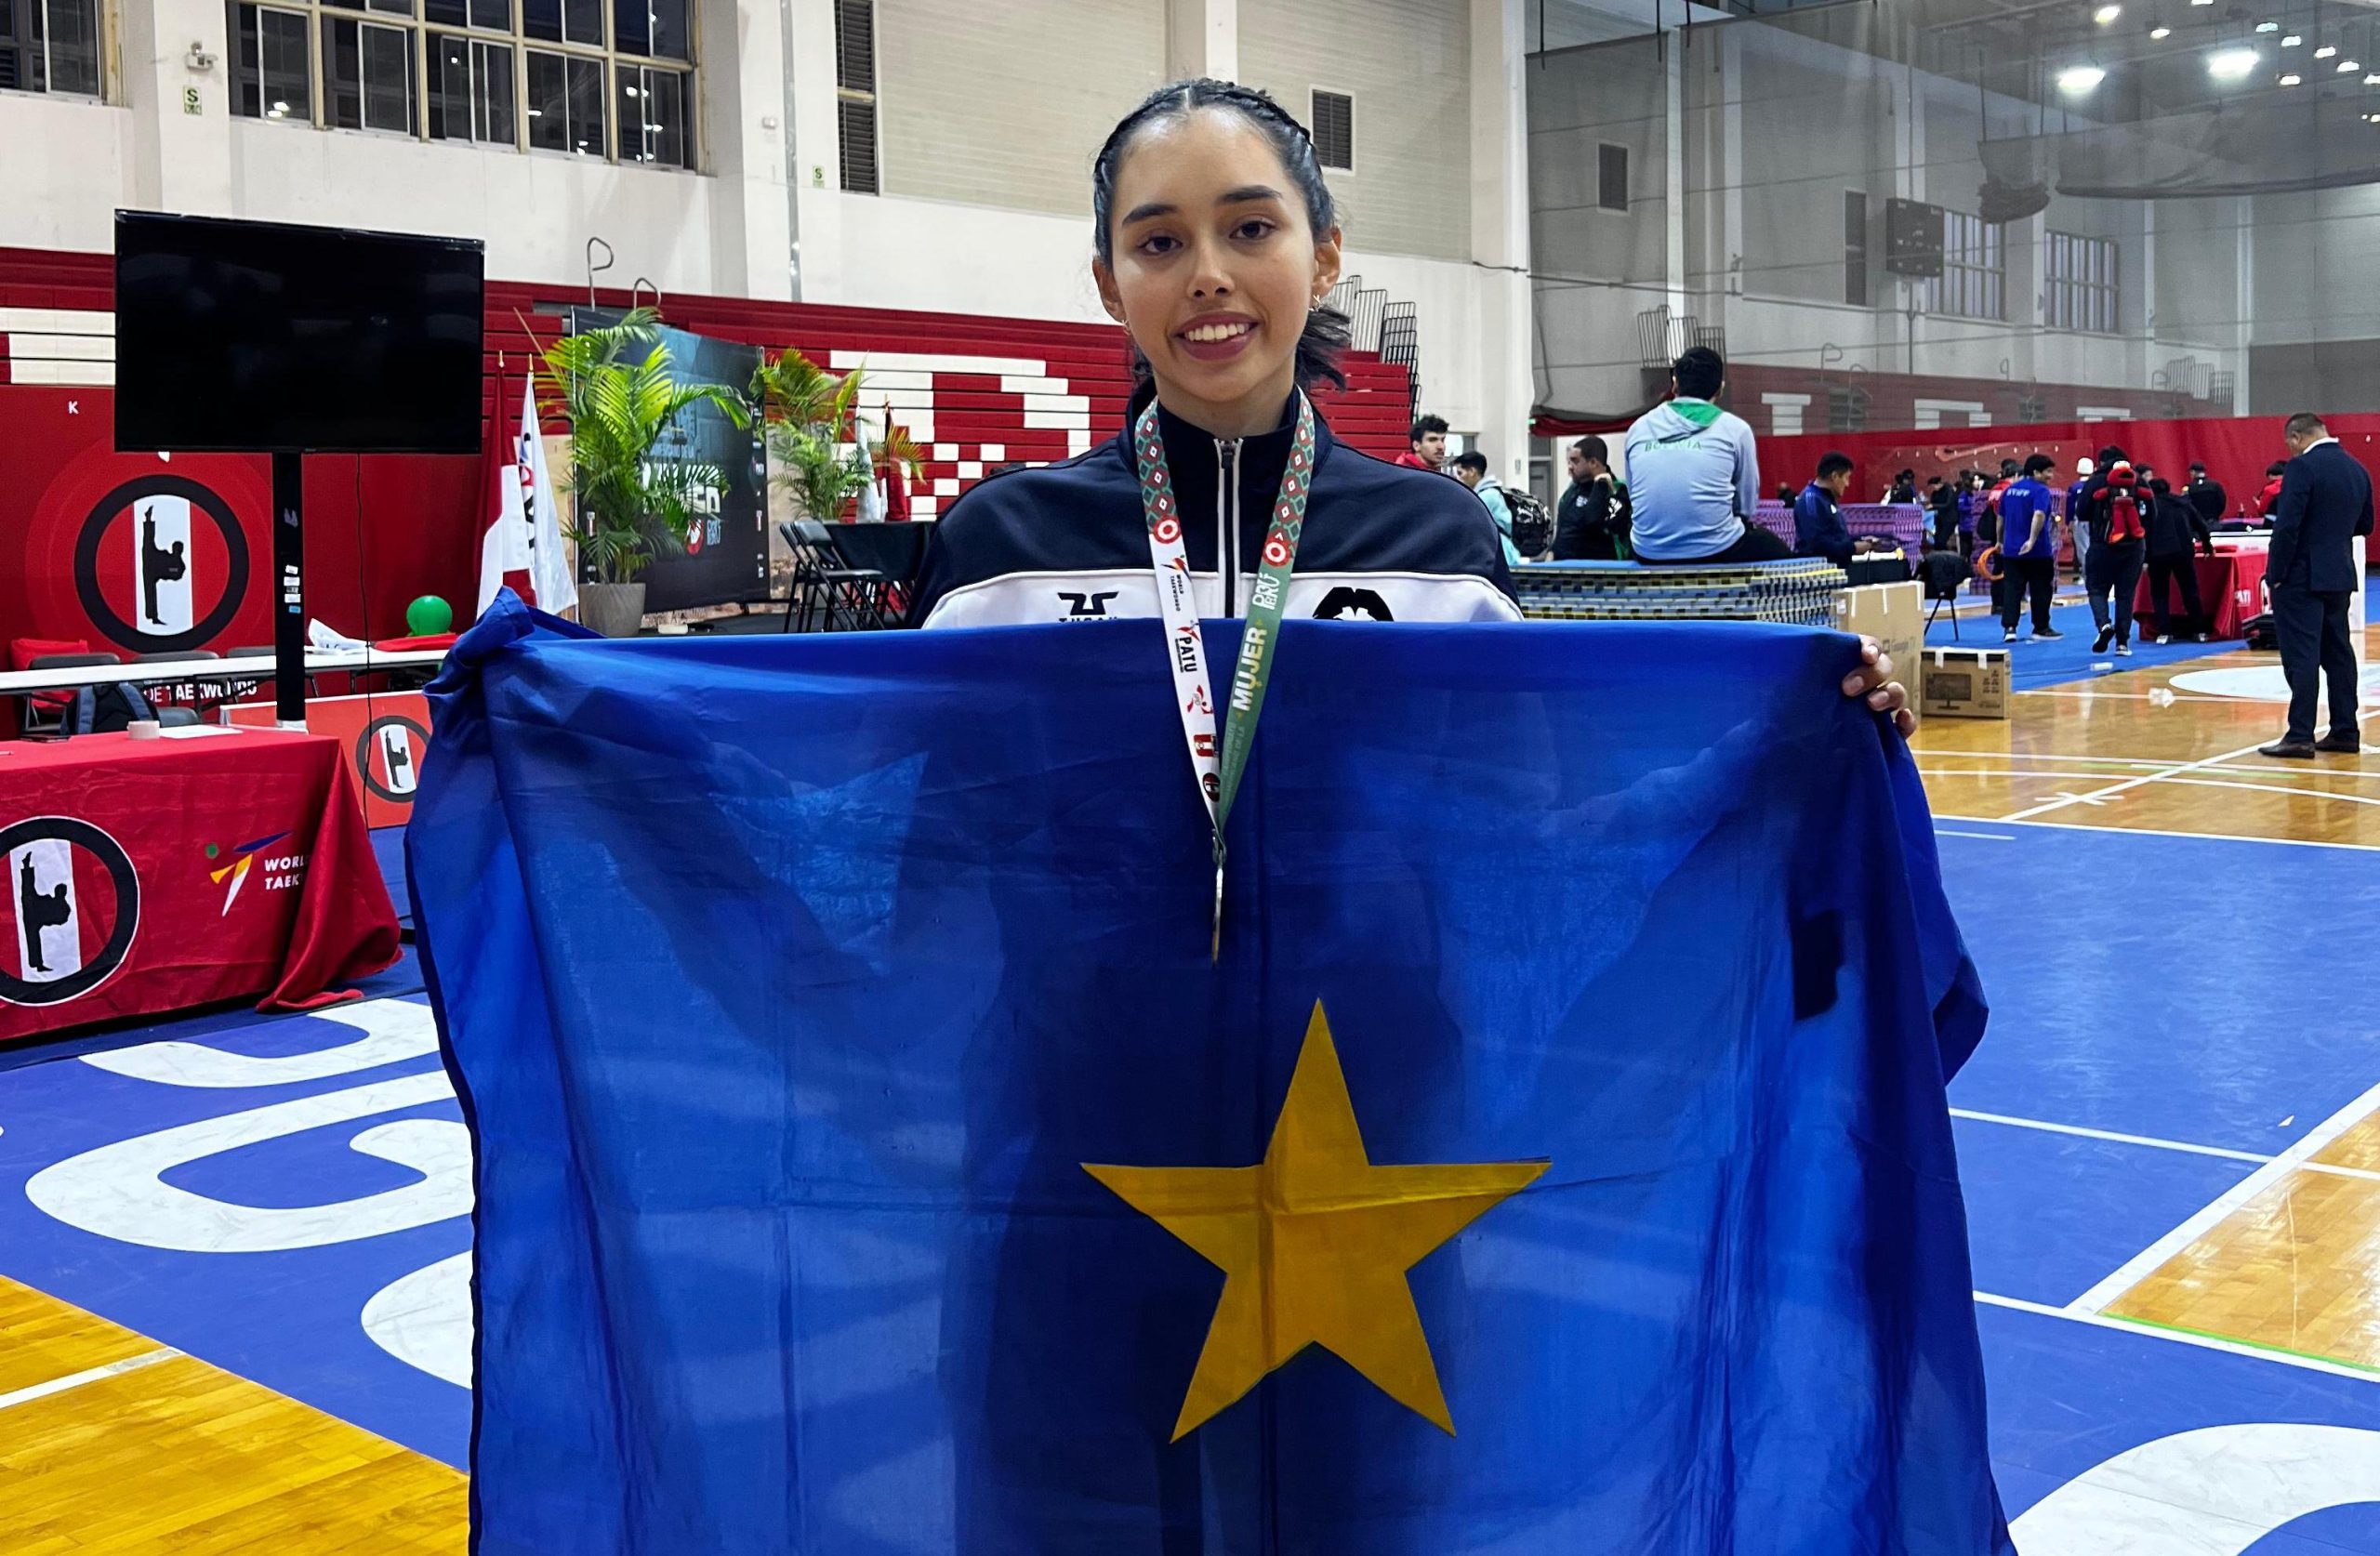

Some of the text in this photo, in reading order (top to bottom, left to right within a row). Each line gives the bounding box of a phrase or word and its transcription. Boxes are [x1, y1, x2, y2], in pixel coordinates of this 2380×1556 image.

[187, 88, 198, 102] S
[814, 167, 822, 179] S
[68, 401, 79, 415] K
[1645, 441, 1702, 452] BOVIA
[1179, 636, 1198, 673] PATU
[1232, 626, 1268, 712] MUJER
[264, 855, 305, 872] WORL
[264, 874, 299, 890] TAEK
